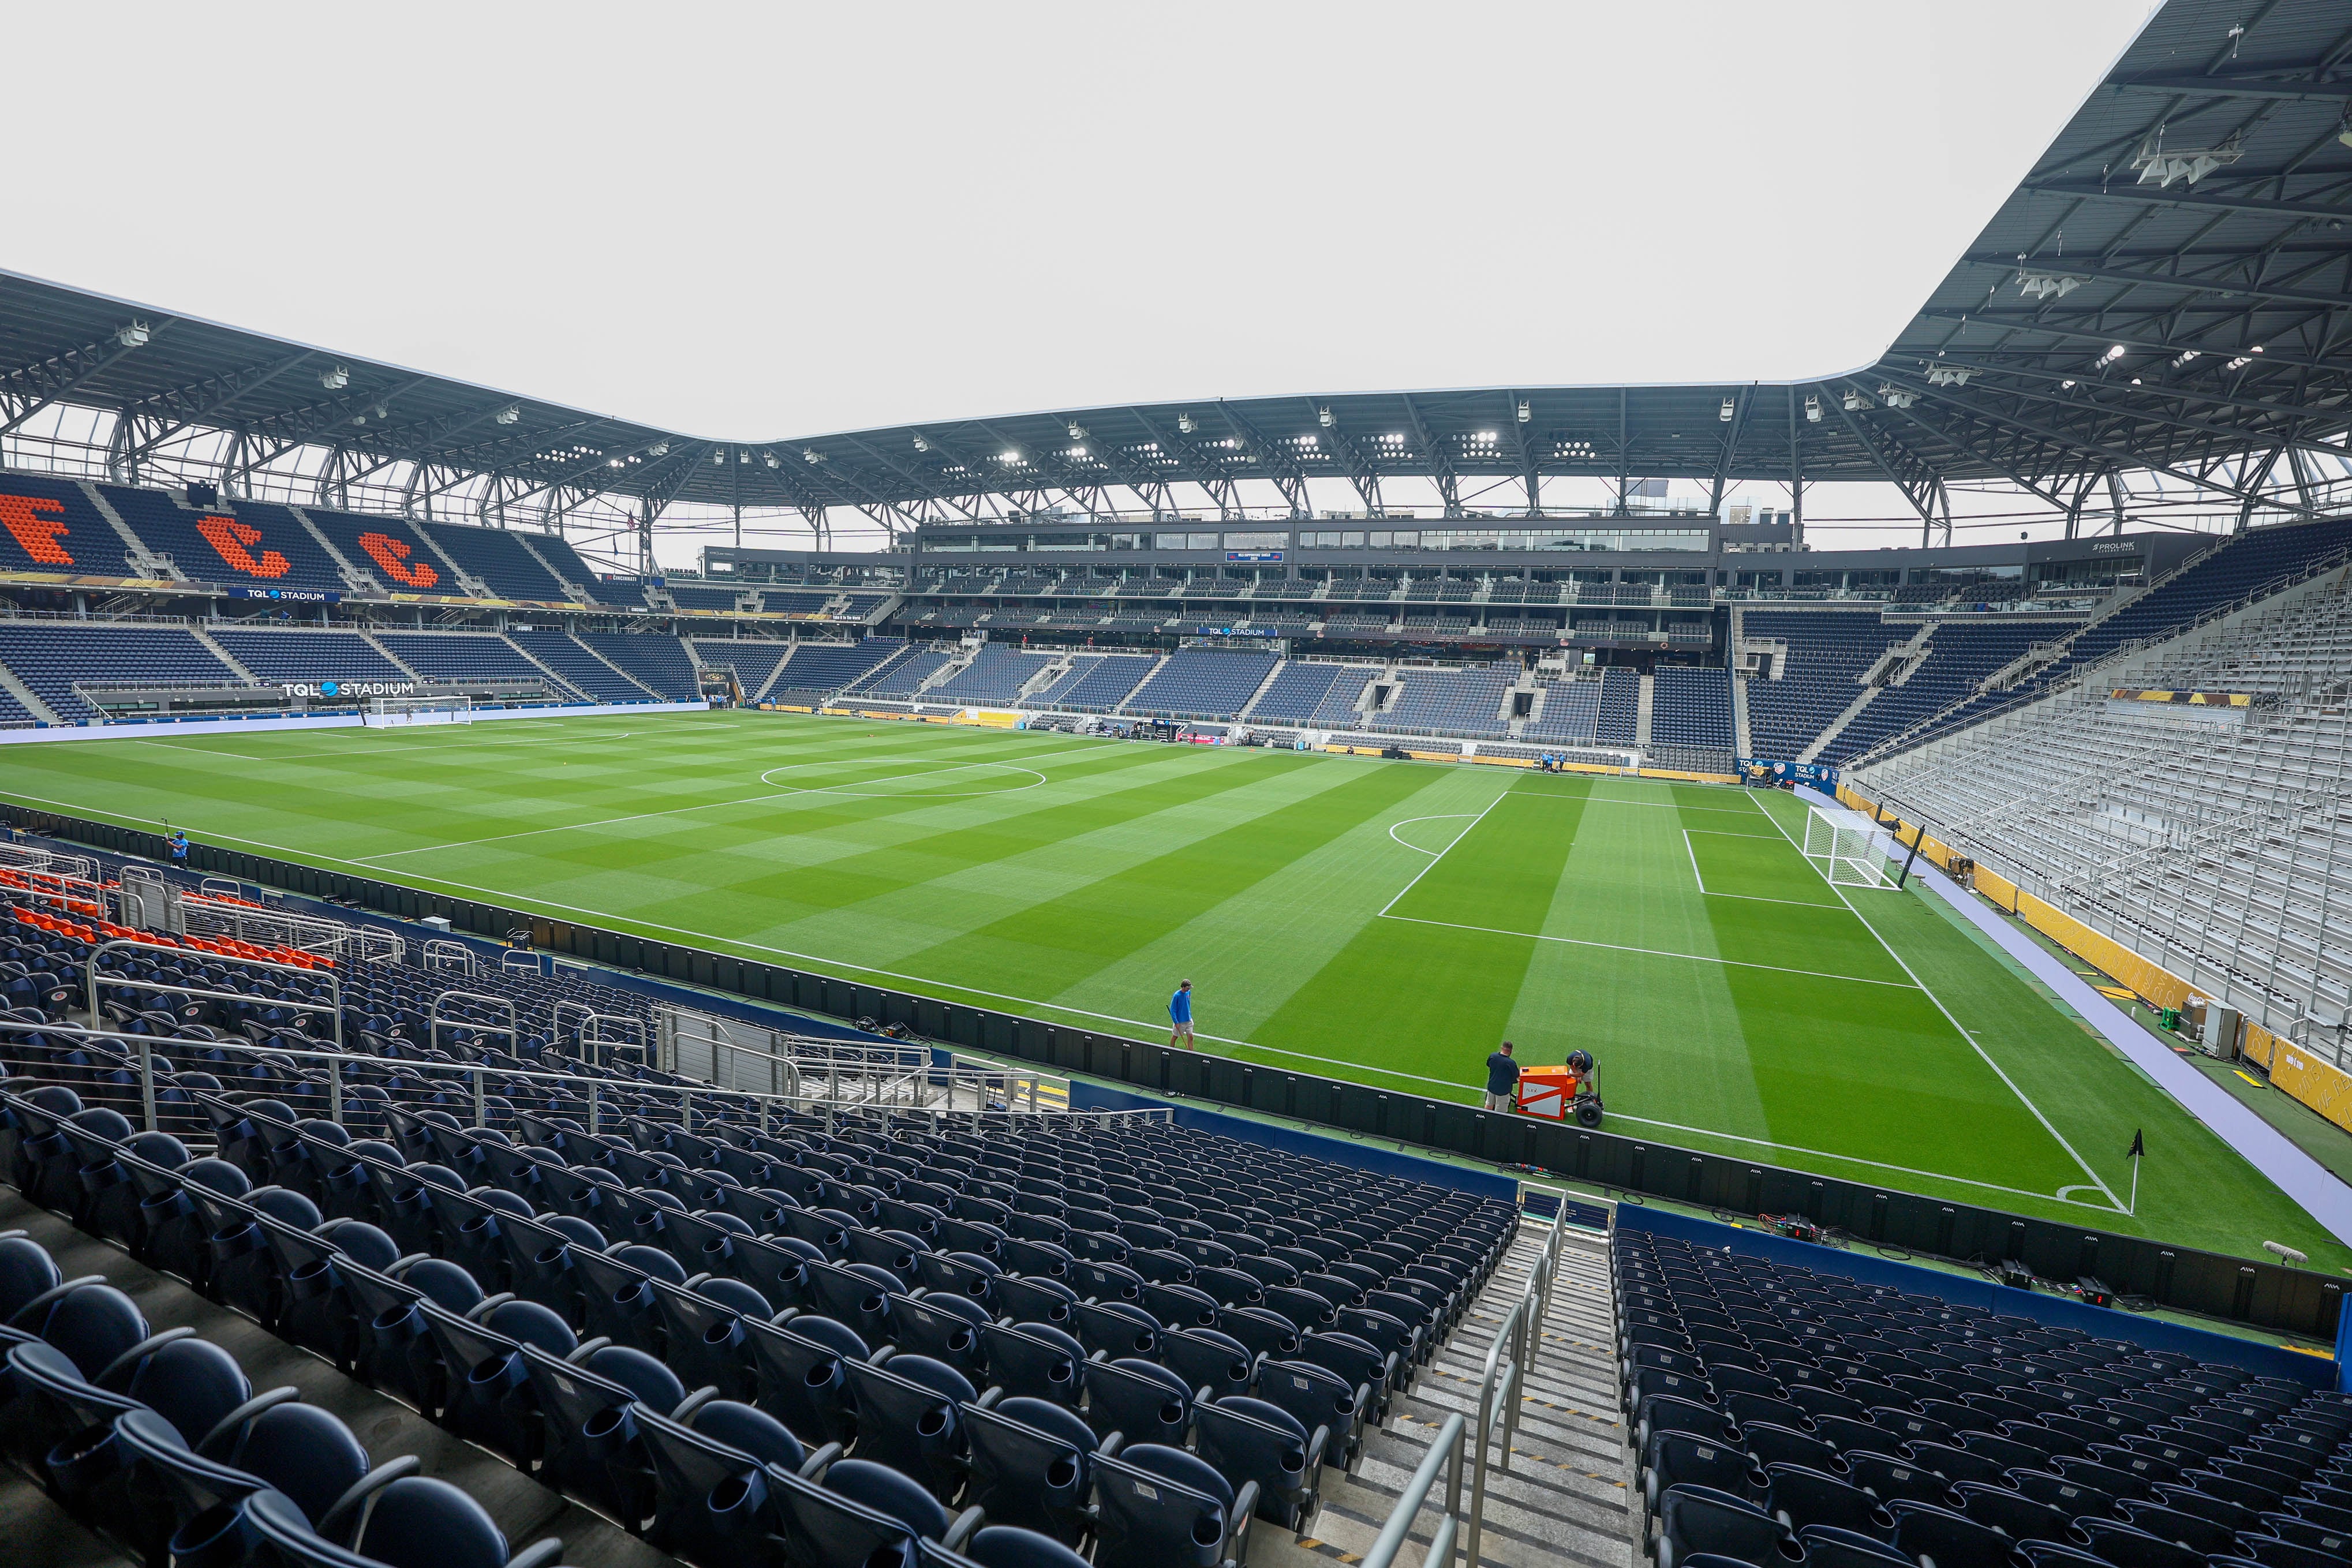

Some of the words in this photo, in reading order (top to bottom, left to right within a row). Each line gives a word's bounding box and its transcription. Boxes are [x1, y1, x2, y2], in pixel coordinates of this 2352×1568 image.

[2099, 541, 2134, 550] PROLINK
[248, 589, 270, 598] TQL
[281, 592, 325, 601] STADIUM
[282, 683, 320, 697] TQL
[341, 682, 414, 695] STADIUM
[1738, 759, 1754, 768] TQL
[1795, 765, 1809, 773] TQL
